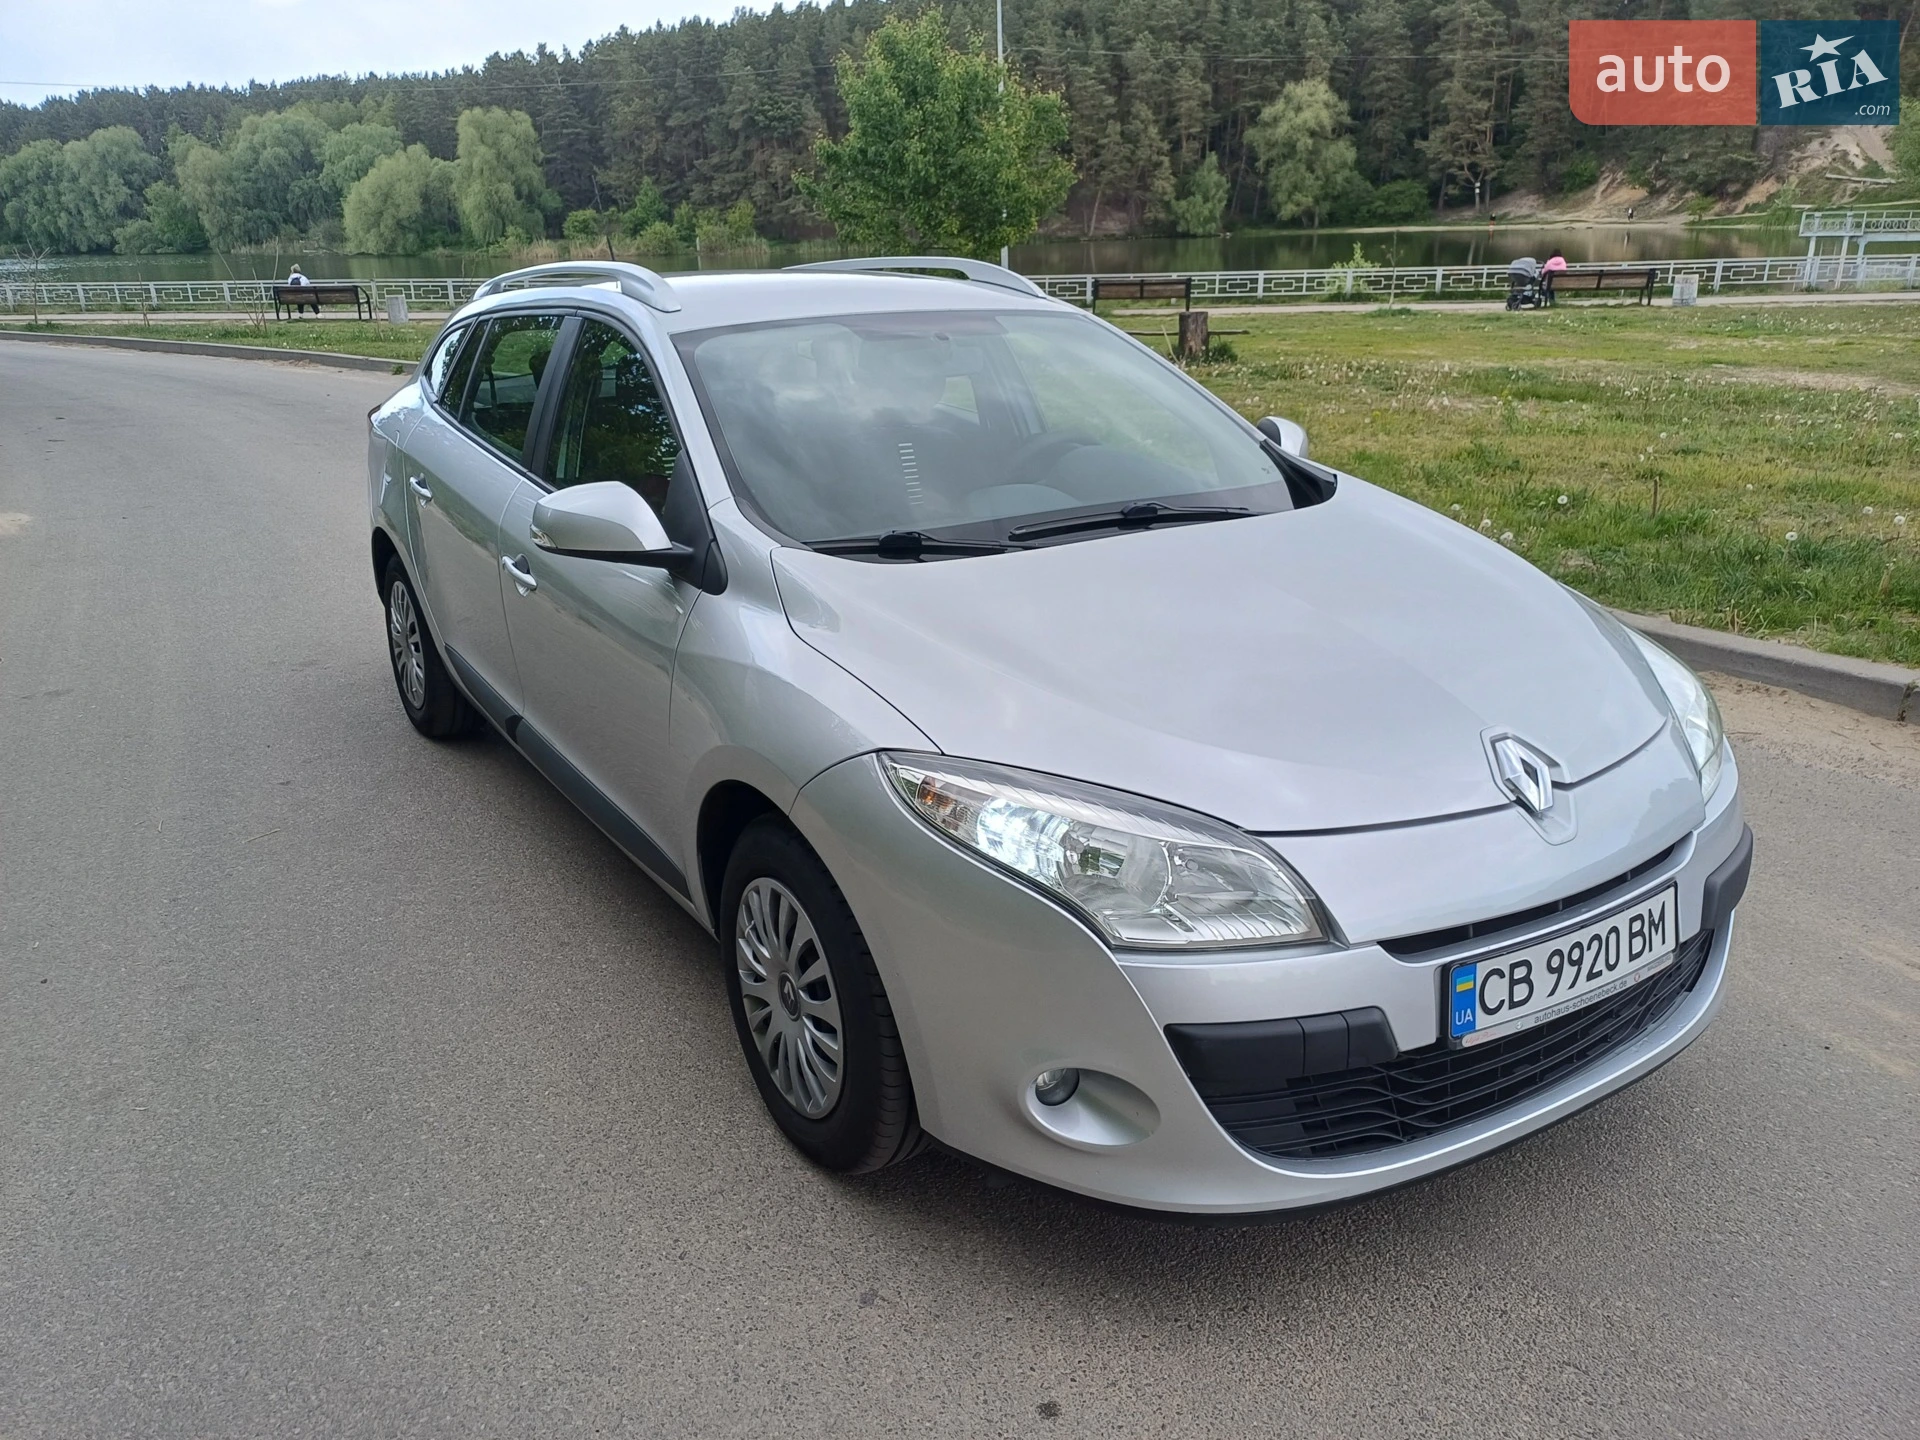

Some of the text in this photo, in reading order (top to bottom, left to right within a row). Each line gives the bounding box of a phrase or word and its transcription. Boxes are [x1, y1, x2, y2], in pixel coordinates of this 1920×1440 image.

[1479, 900, 1666, 1016] CB 9920 BM
[1455, 1008, 1473, 1026] UA
[1534, 980, 1628, 1024] autohaus-schoenebeck.de
